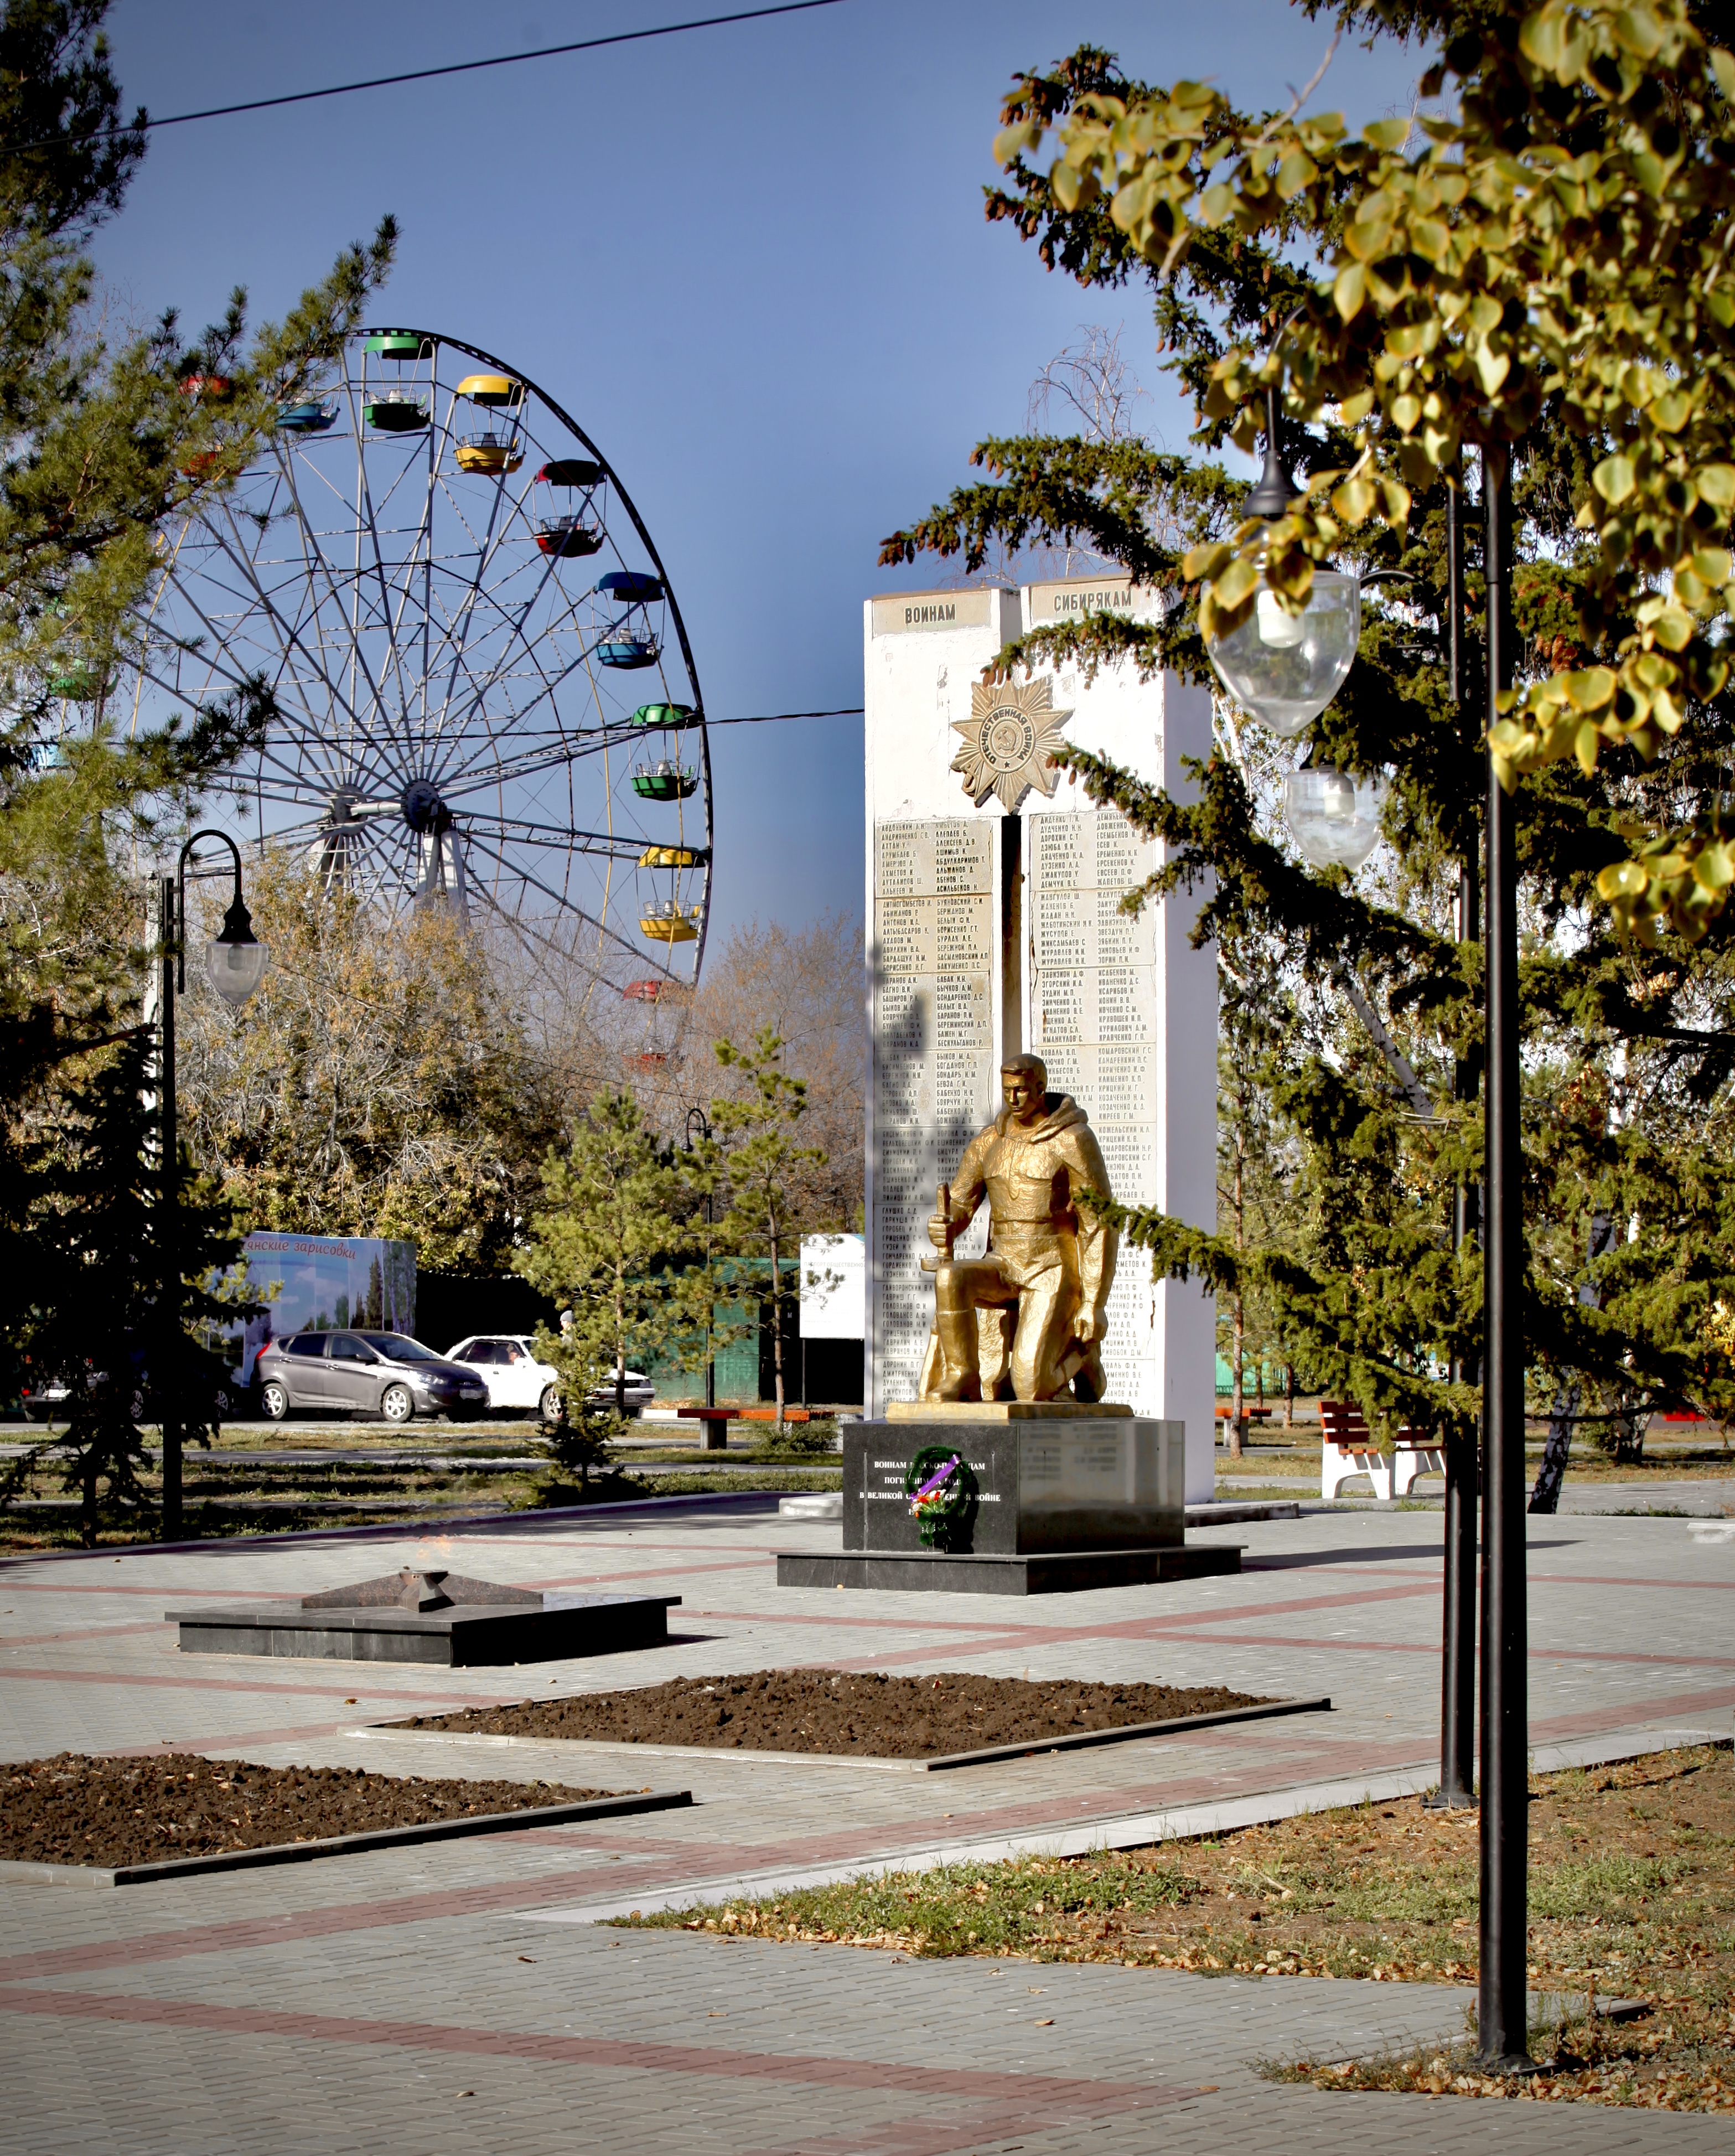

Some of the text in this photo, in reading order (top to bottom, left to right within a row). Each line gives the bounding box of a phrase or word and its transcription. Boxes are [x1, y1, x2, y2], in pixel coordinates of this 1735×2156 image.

[905, 590, 1132, 624] ВОИНАМ СИБИРЯКАМ
[982, 709, 1028, 764] ОТЕЧЕСТВЕННАЯ
[294, 1242, 356, 1260] зарисовки
[874, 1461, 907, 1469] ВОИНАМ
[867, 1491, 903, 1500] ВЕЛИКОЙ
[975, 1492, 1001, 1502] ВОЙНЕ
